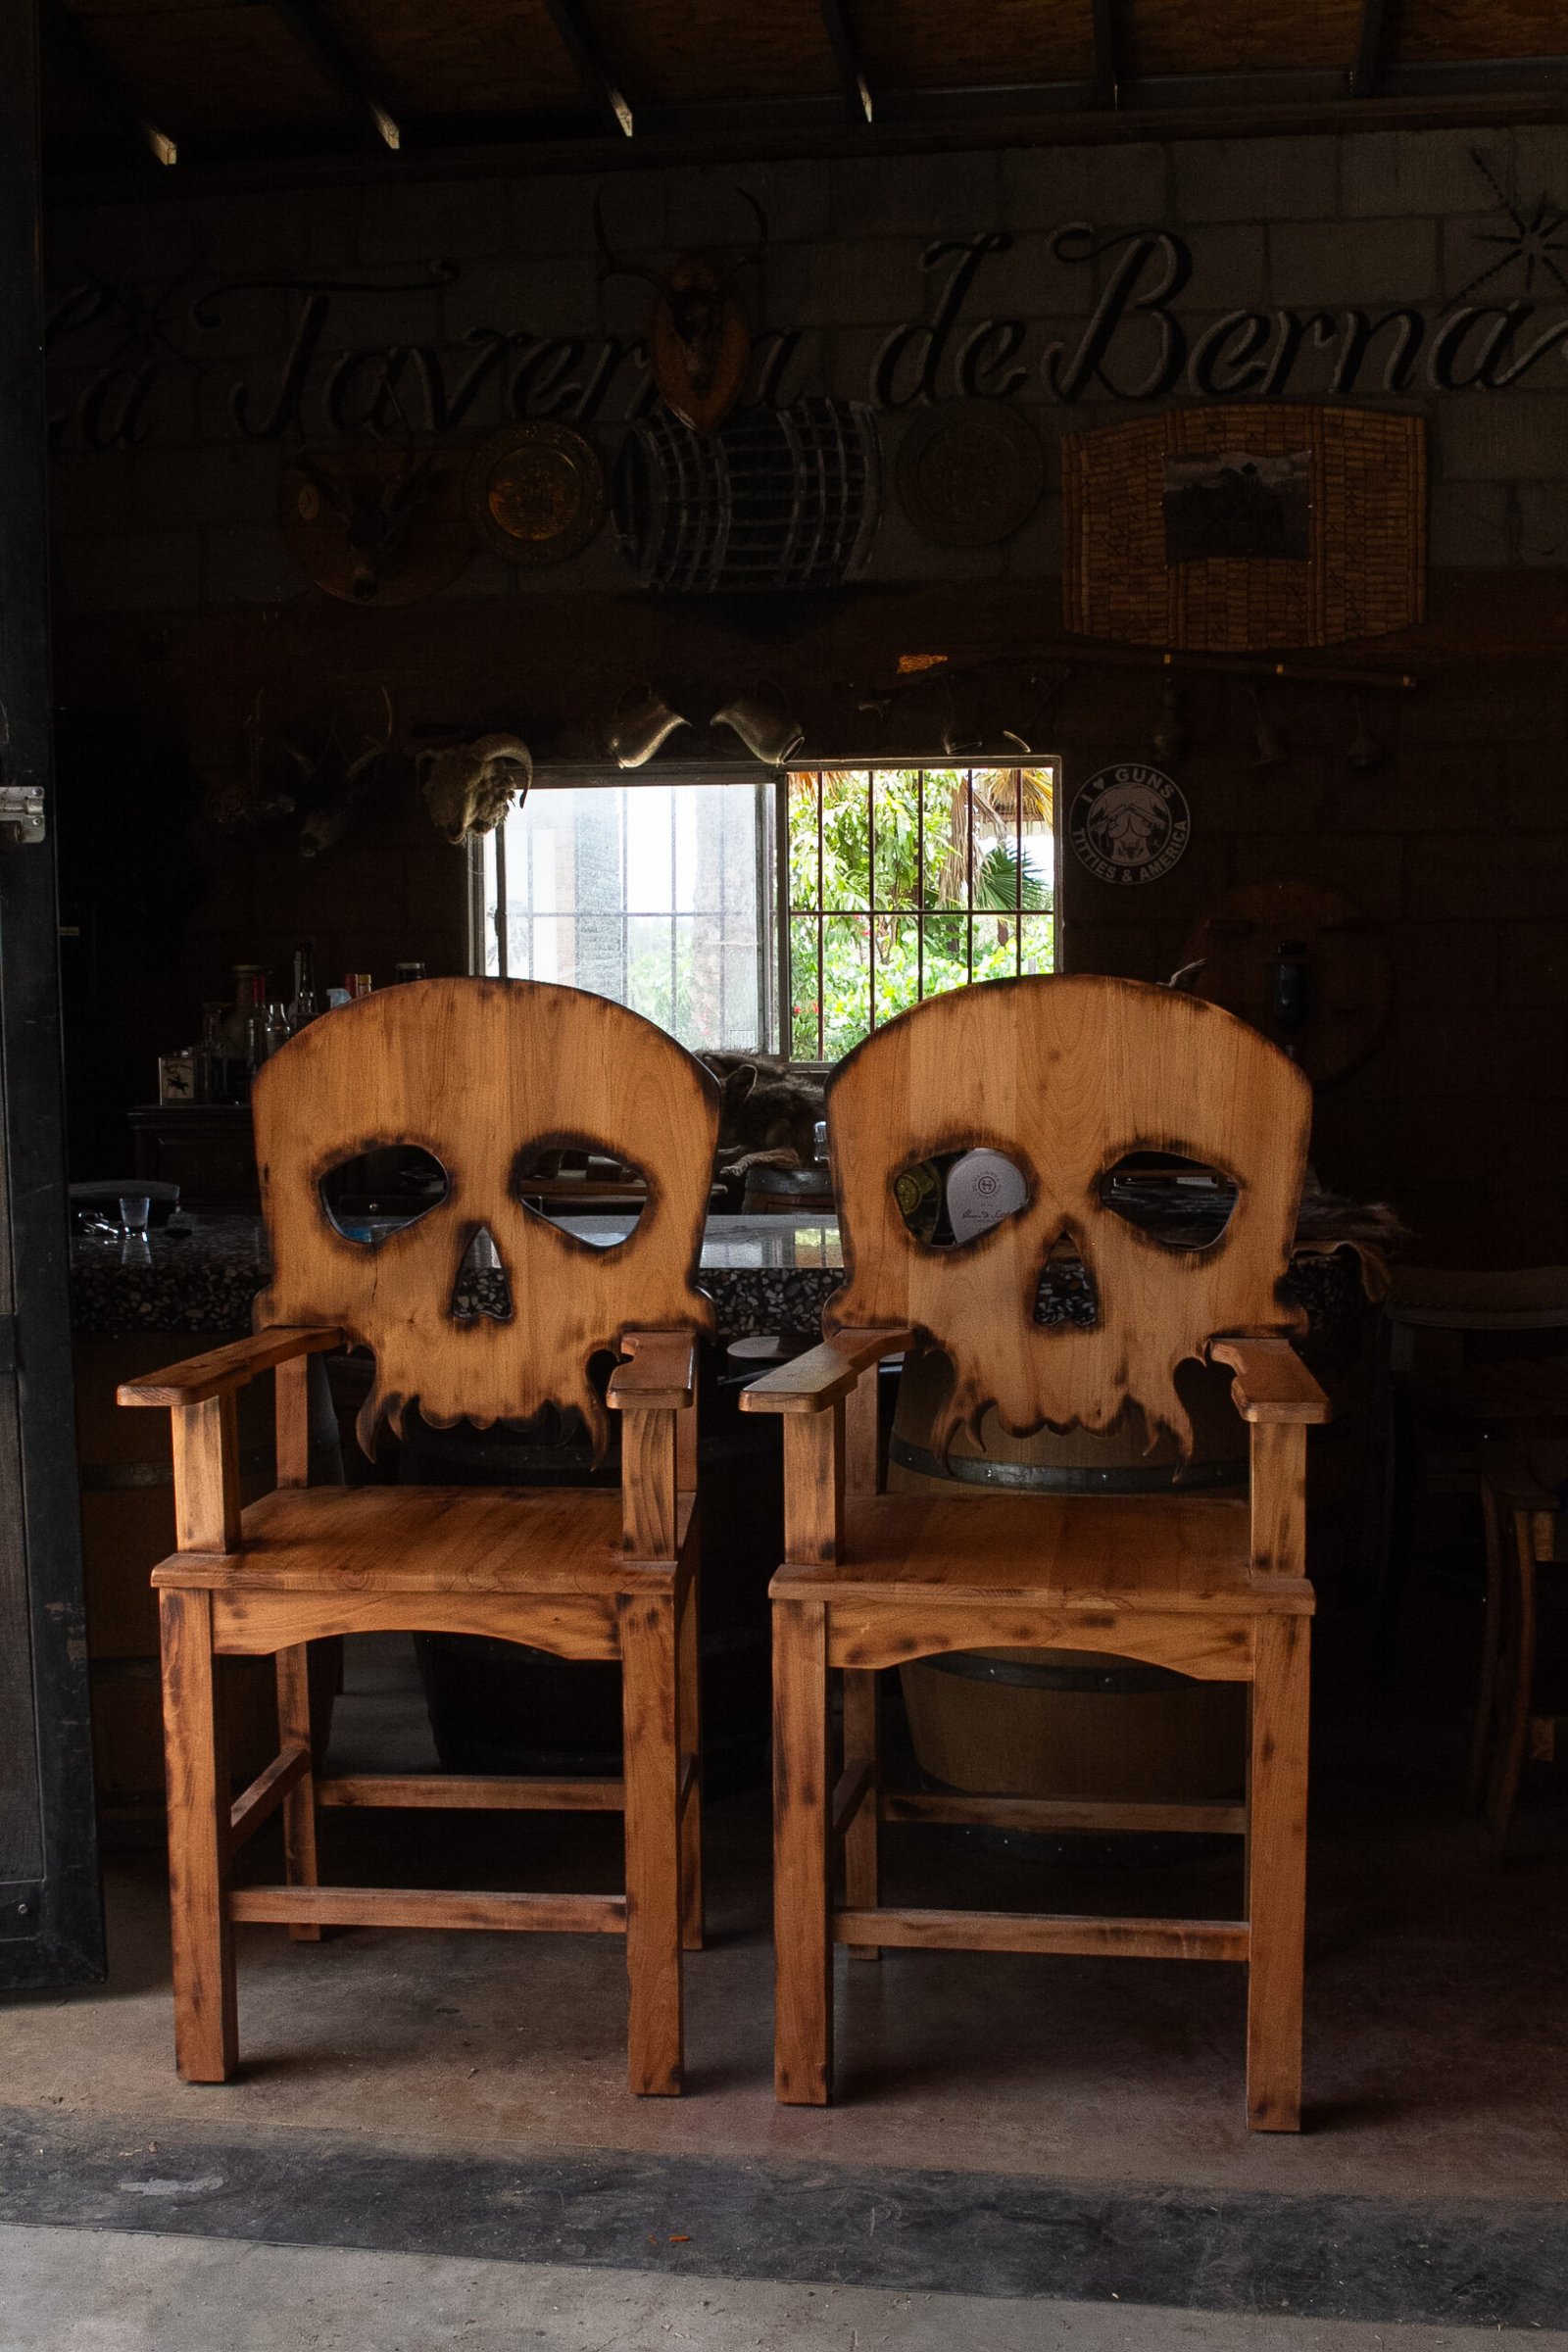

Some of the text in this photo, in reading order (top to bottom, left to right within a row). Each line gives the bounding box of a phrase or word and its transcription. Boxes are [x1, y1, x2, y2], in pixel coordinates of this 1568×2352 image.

[193, 257, 802, 437] Tavera
[870, 232, 1029, 408] de
[1081, 768, 1174, 803] I GUNS
[1073, 820, 1188, 882] TITTIES & AMERICA
